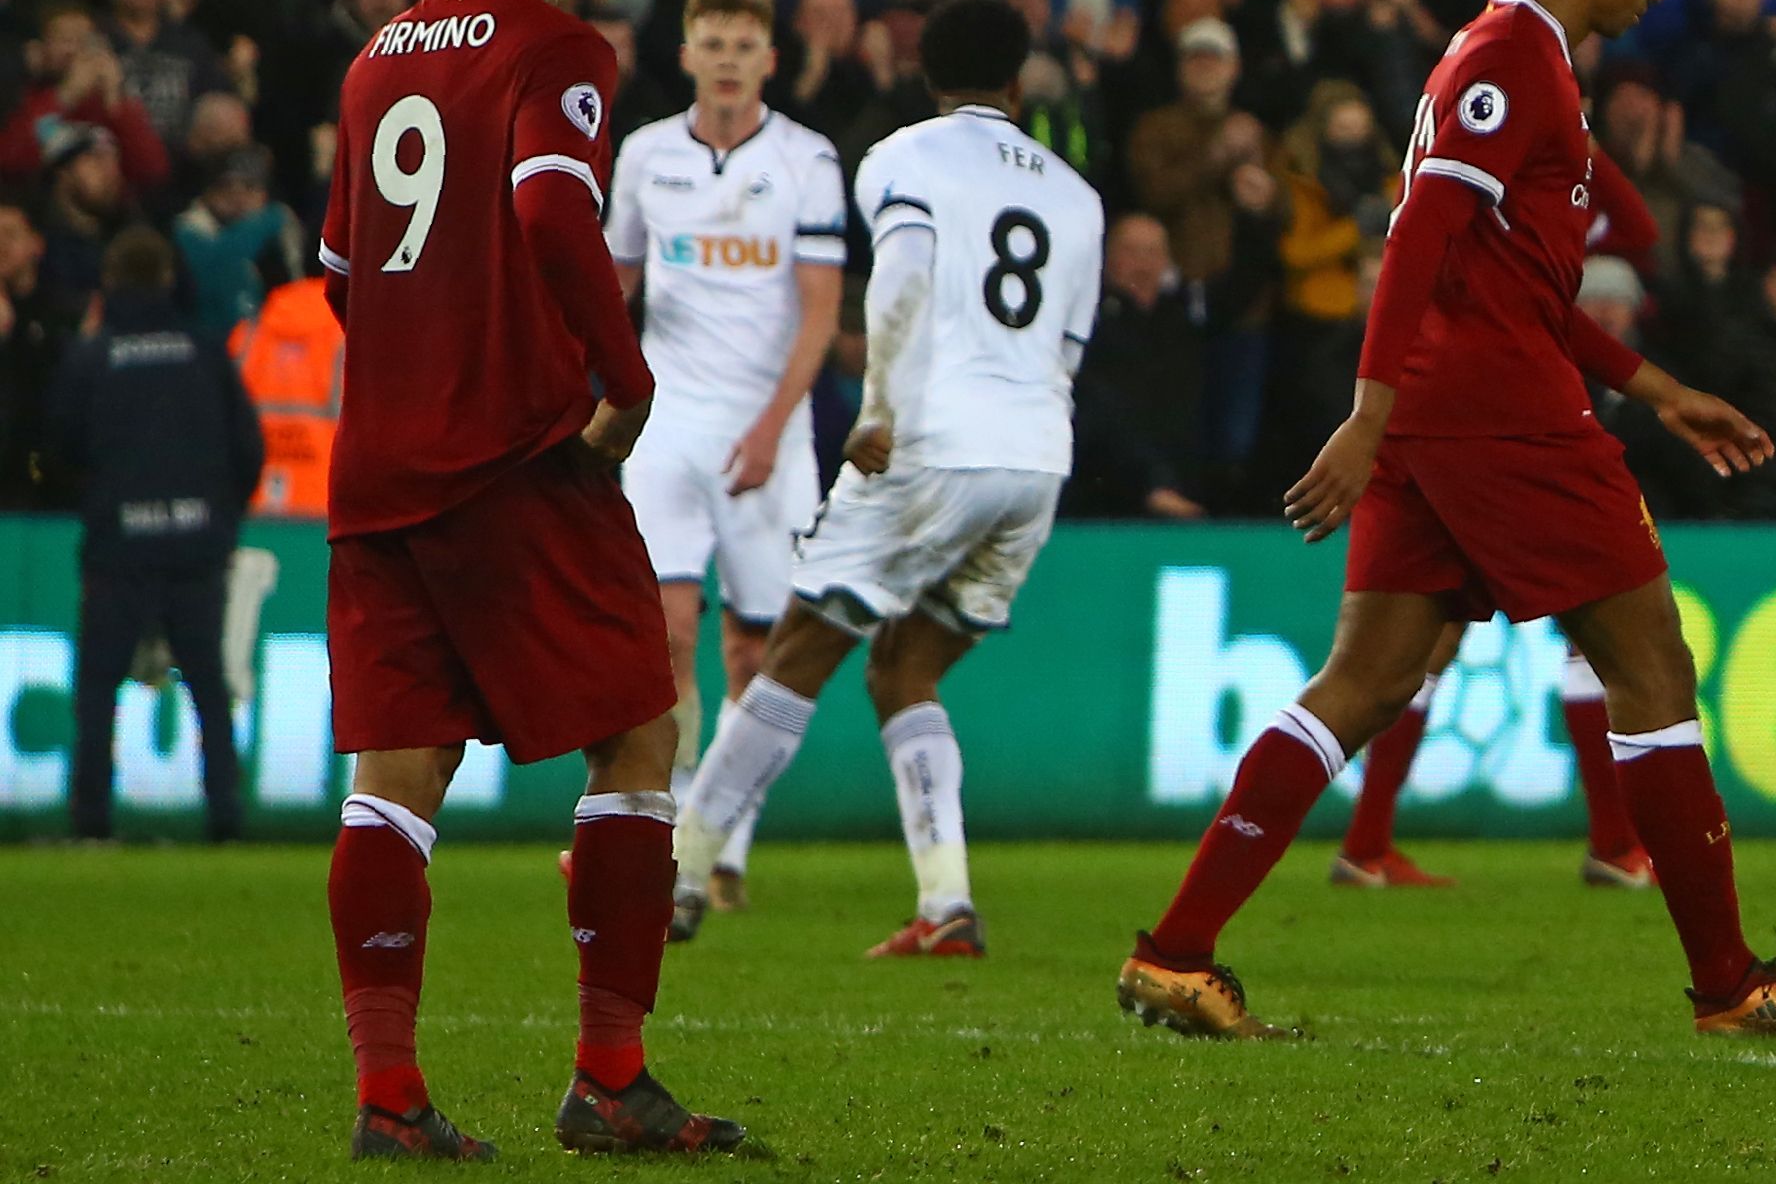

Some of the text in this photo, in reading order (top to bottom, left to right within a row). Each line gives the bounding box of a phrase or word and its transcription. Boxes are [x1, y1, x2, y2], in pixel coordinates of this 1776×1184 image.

[368, 12, 496, 58] FIRMINO
[997, 142, 1045, 175] FER
[372, 94, 447, 272] 9
[660, 233, 779, 269] LETOU
[984, 205, 1050, 329] 8
